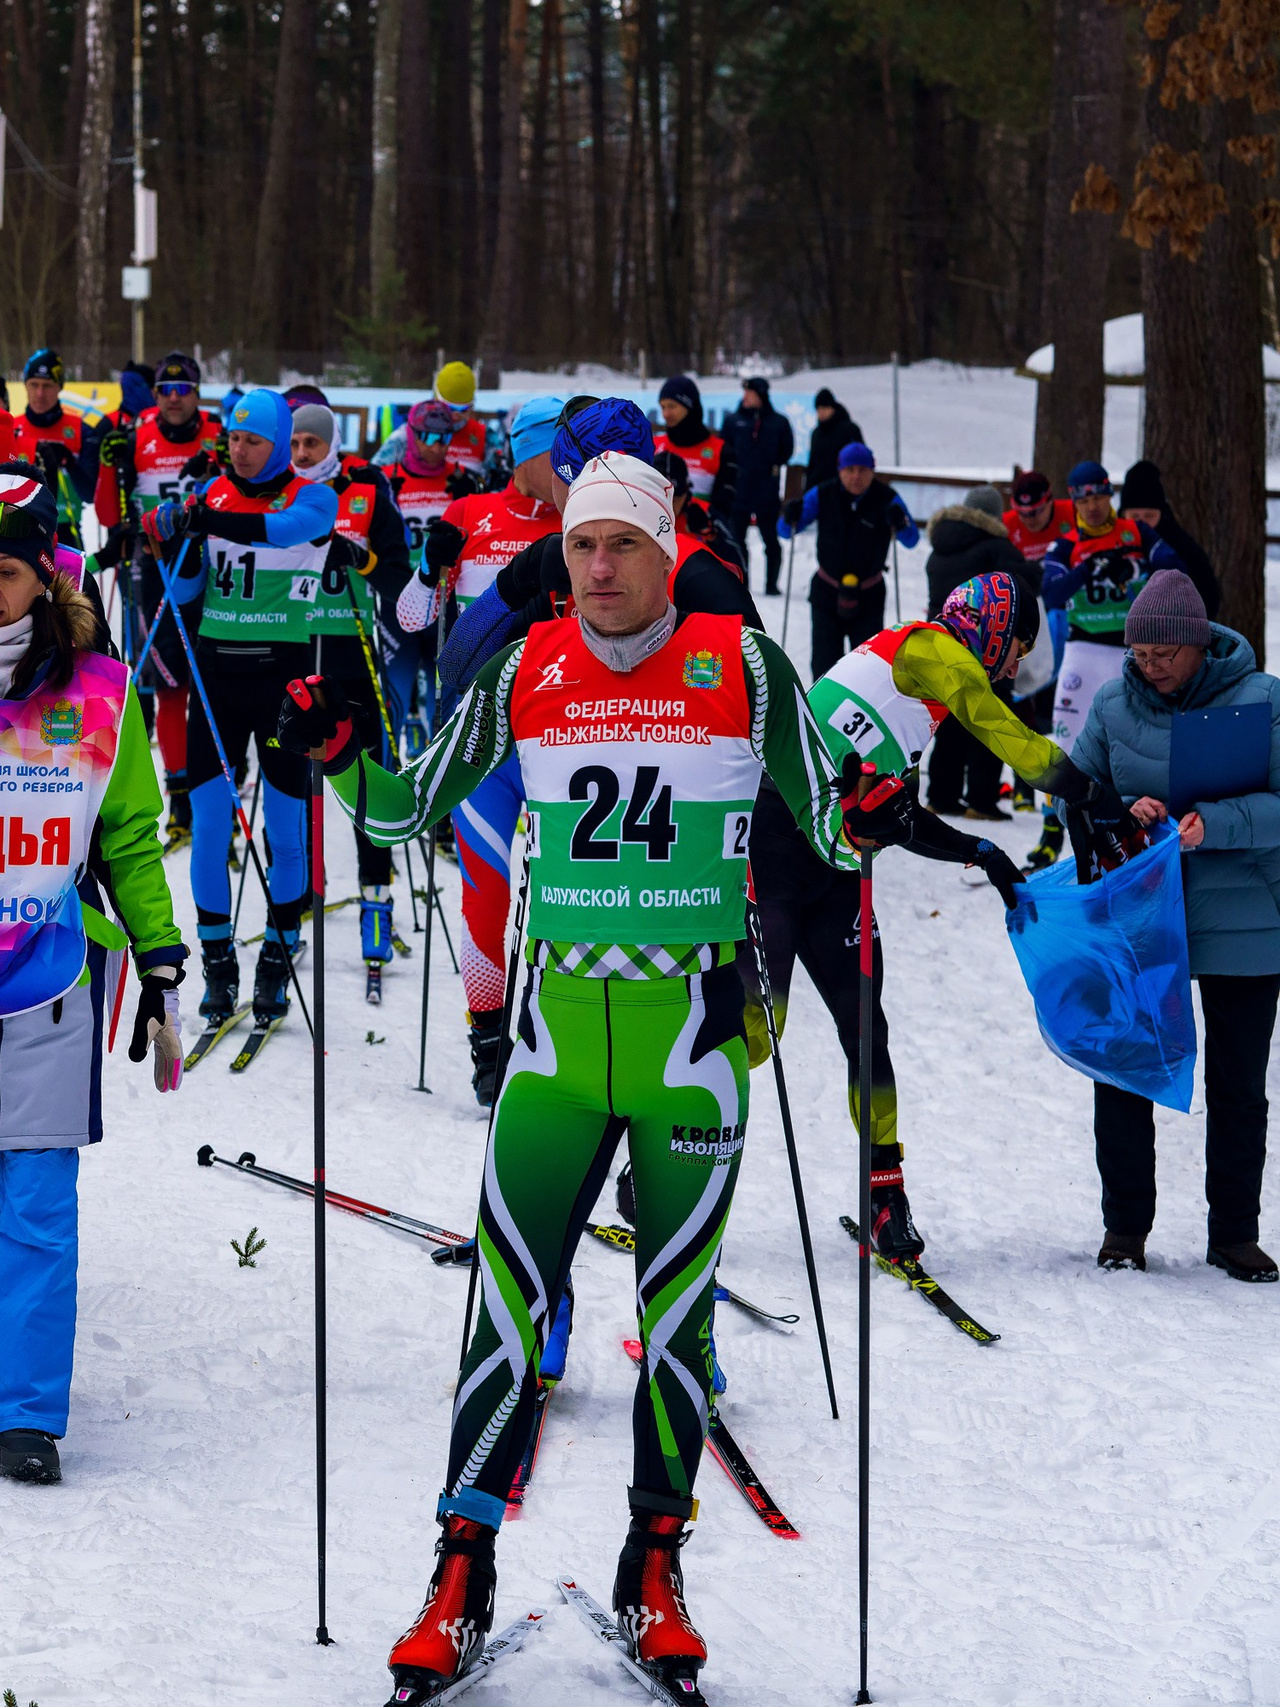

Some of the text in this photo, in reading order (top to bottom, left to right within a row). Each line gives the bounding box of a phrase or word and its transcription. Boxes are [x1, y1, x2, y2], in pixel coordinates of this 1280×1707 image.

[215, 550, 256, 600] 41
[239, 612, 288, 624] ОБЛАСТИ
[647, 628, 669, 650] CRAFT
[564, 698, 686, 721] ФЕДЕРАЦИЯ
[540, 722, 711, 747] ЛЫЖНЫХ ГОНОК
[842, 711, 874, 744] 31
[16, 766, 70, 777] ШКОЛА
[22, 781, 84, 793] РЕЗЕРВА
[568, 764, 678, 863] 24
[541, 886, 721, 907] КАЛУЖСКОЙ ОБЛАСТИ
[670, 1135, 744, 1156] ИЗОЛЯЦИЯ
[668, 1153, 708, 1167] ГРУППА
[594, 1225, 636, 1251] FISCH
